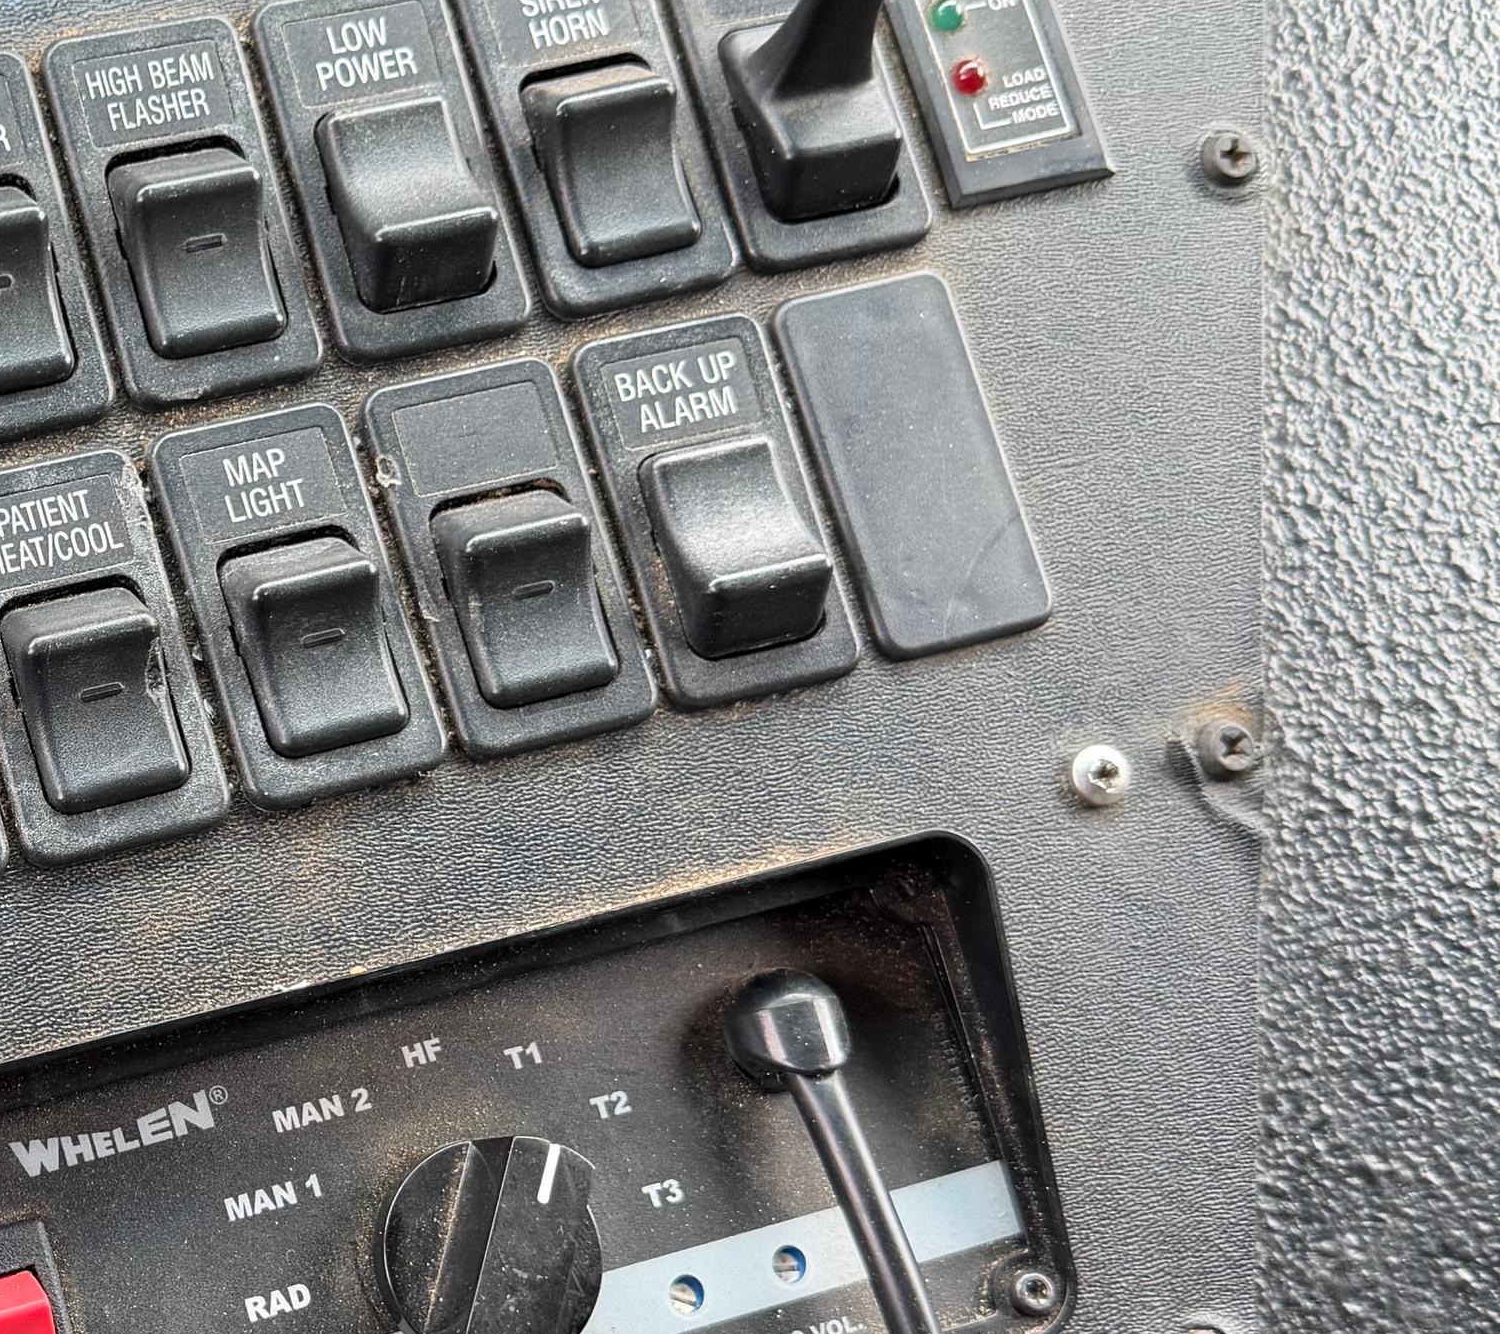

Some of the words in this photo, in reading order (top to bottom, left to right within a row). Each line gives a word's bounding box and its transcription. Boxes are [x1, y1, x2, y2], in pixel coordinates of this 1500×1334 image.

[326, 17, 389, 56] LOW
[528, 8, 610, 51] HORN
[86, 62, 143, 99] HIGH
[148, 52, 214, 88] BEAM
[315, 47, 418, 91] POWER
[1002, 66, 1047, 89] LOAD
[106, 88, 212, 133] FLASHER
[987, 83, 1054, 111] REDUCE
[1011, 101, 1061, 124] MODE
[613, 361, 691, 404] BACK
[698, 349, 738, 384] UP
[638, 385, 739, 434] ALARM
[223, 448, 287, 486] MAP
[224, 480, 309, 524] LIGHT
[401, 1037, 443, 1069] HF
[503, 1041, 543, 1070] T1
[272, 1098, 345, 1134] MAN
[349, 1087, 373, 1113] 2
[590, 1090, 633, 1121] T2
[224, 1185, 298, 1222] MAN
[304, 1173, 323, 1199] 1
[641, 1177, 685, 1208] T3
[244, 1282, 312, 1323] RAD
